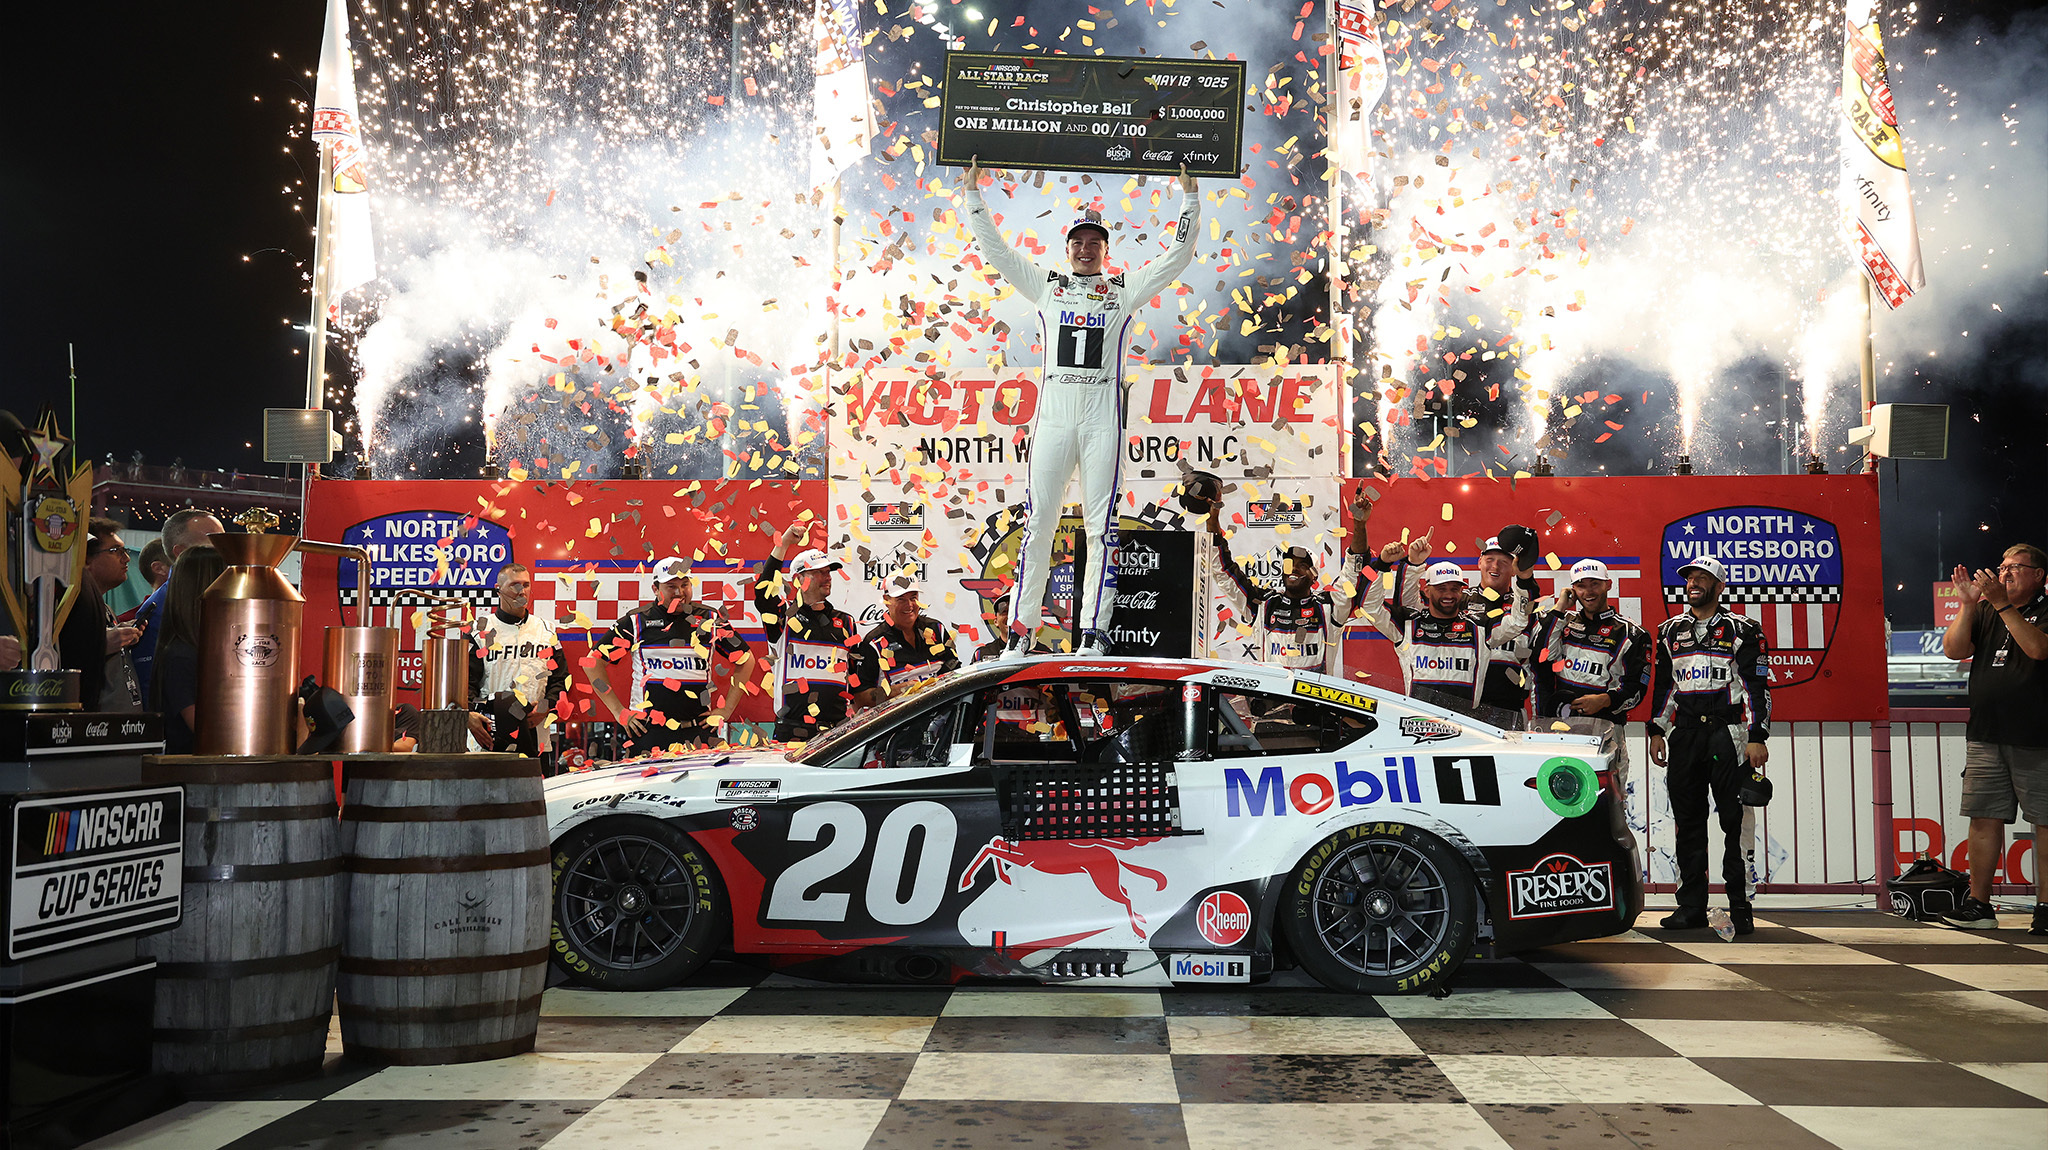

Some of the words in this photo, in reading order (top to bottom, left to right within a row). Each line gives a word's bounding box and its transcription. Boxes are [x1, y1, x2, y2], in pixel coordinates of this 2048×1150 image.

[957, 70, 981, 80] ALL
[983, 71, 1015, 82] STAR
[1015, 73, 1049, 83] RACE
[1148, 74, 1179, 87] MAY
[1006, 98, 1099, 115] Christopher
[1102, 102, 1132, 116] Bell
[1158, 106, 1166, 119] $
[1170, 107, 1226, 120] 1,000,000
[954, 116, 988, 130] ONE
[991, 118, 1062, 133] MILLION
[1065, 123, 1088, 133] AND
[1850, 99, 1890, 147] RACE
[1106, 149, 1132, 159] BUSCH
[1182, 150, 1220, 164] xfinity
[1854, 173, 1896, 223] xfinity
[1060, 310, 1106, 327] Mobil
[1071, 329, 1088, 366] 1
[847, 380, 1038, 426] VICTO
[1148, 378, 1320, 424] LANE
[920, 437, 1004, 463] NORTH
[385, 520, 469, 538] NORTH
[1706, 515, 1794, 534] NORTH
[1667, 540, 1834, 559] WILKESBORO
[1119, 552, 1160, 570] USCH
[368, 567, 492, 586] SPEEDWAY
[1118, 567, 1148, 576] LIGHT
[1436, 568, 1454, 577] Mobil
[1724, 564, 1821, 583] EEDWAY
[1107, 624, 1161, 647] xfinity
[485, 643, 551, 662] OFFICIA
[1767, 655, 1814, 666] ROLINA
[358, 659, 385, 669] BORN
[647, 657, 692, 670] Mobil
[791, 653, 831, 670] Mobi
[1416, 655, 1453, 670] Mobil
[1564, 658, 1590, 673] obil
[366, 671, 378, 680] TO
[1675, 665, 1710, 682] Mobil
[357, 682, 385, 691] SHINE
[52, 727, 73, 739] BUSCH
[121, 720, 146, 736] xfinity
[1406, 725, 1457, 735] BATTERIES
[1224, 756, 1422, 818] Mobil
[1449, 759, 1475, 802] 1
[572, 790, 687, 811] GOOYEAR
[733, 807, 757, 817] NASCAR
[76, 801, 164, 851] NASCAR
[732, 821, 756, 832] SALUTES
[766, 801, 958, 926] 20
[38, 871, 91, 920] CUP
[90, 859, 164, 909] SERIES
[682, 851, 712, 912] EAGLE
[1516, 868, 1607, 912] RESER'S
[1540, 900, 1558, 909] FINE
[1559, 898, 1584, 907] FOODS
[466, 916, 503, 926] FAMILY
[1203, 893, 1247, 937] Rheem
[1176, 960, 1225, 977] Mobil
[1397, 950, 1451, 992] EAGLE
